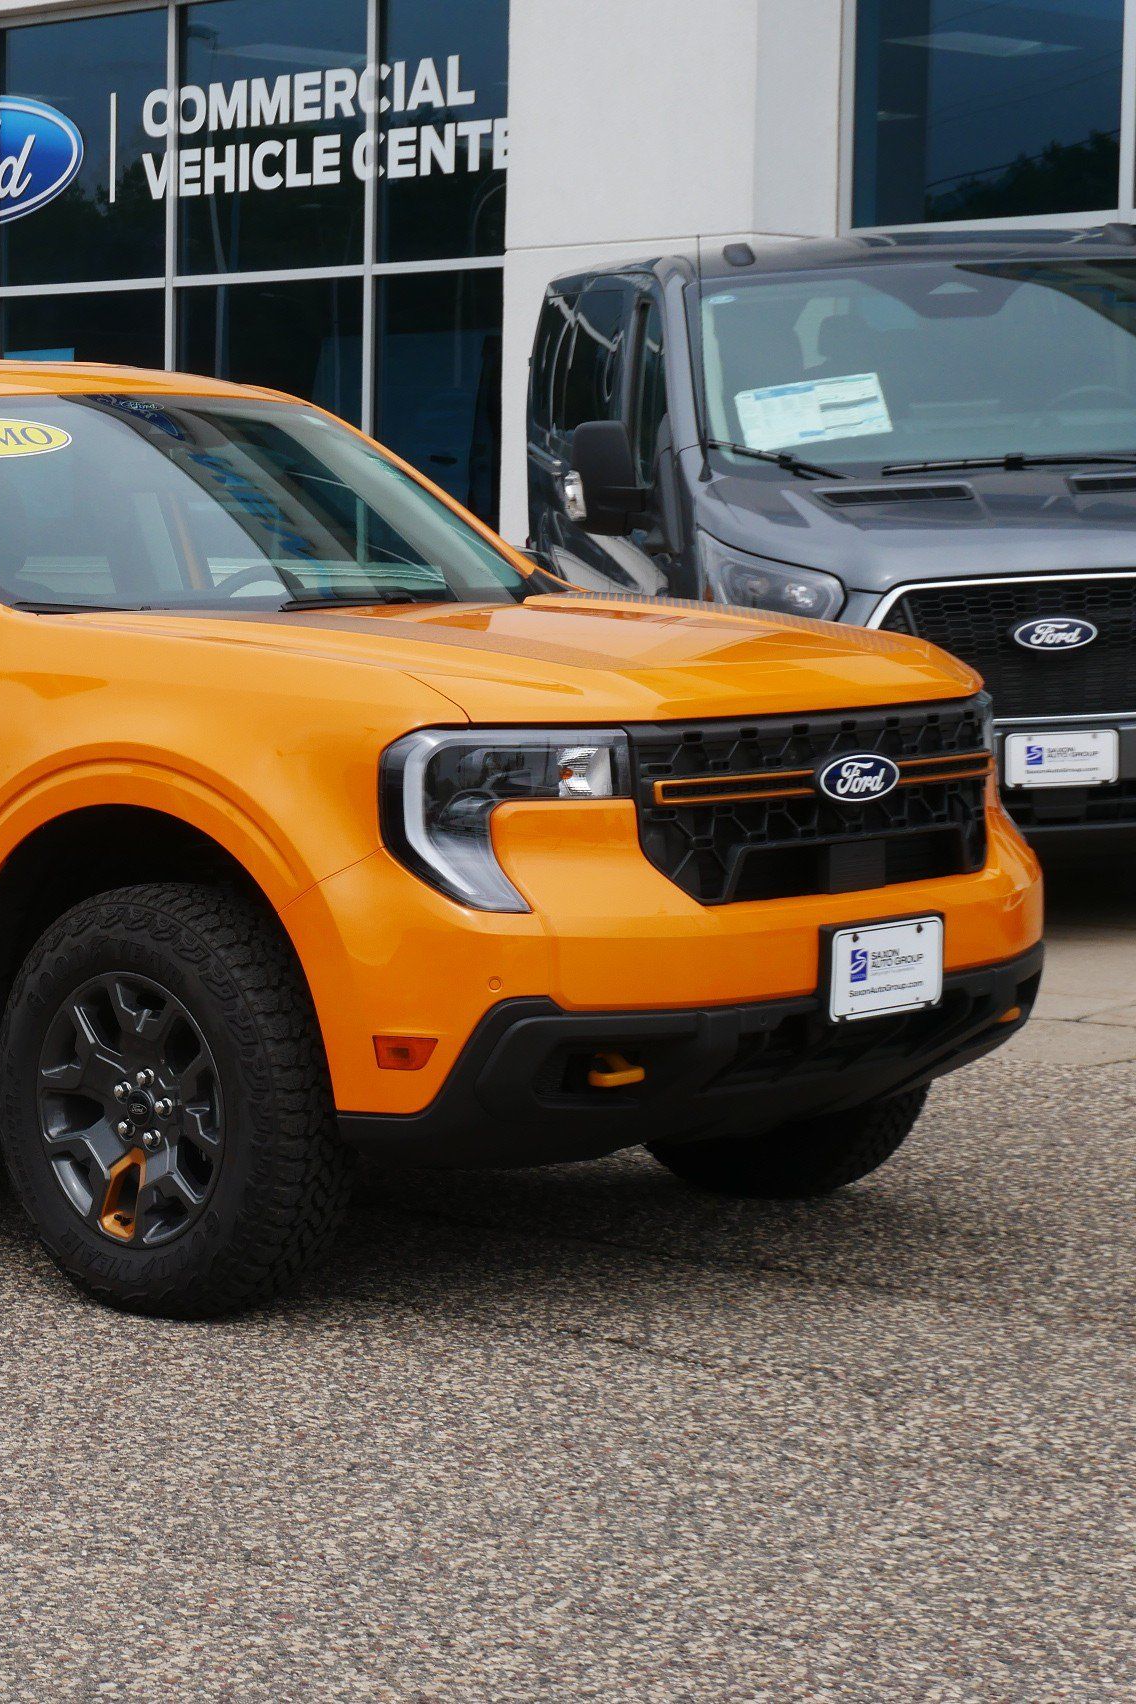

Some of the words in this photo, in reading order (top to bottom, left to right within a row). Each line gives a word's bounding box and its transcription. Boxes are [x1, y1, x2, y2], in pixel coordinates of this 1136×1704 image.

[143, 54, 476, 138] COMMERCIAL
[141, 135, 342, 200] VEHICLE
[1029, 623, 1083, 645] Ford
[835, 761, 886, 795] Ford
[870, 948, 900, 961] SAXON
[871, 957, 893, 969] AUTO
[895, 952, 924, 966] GROUP
